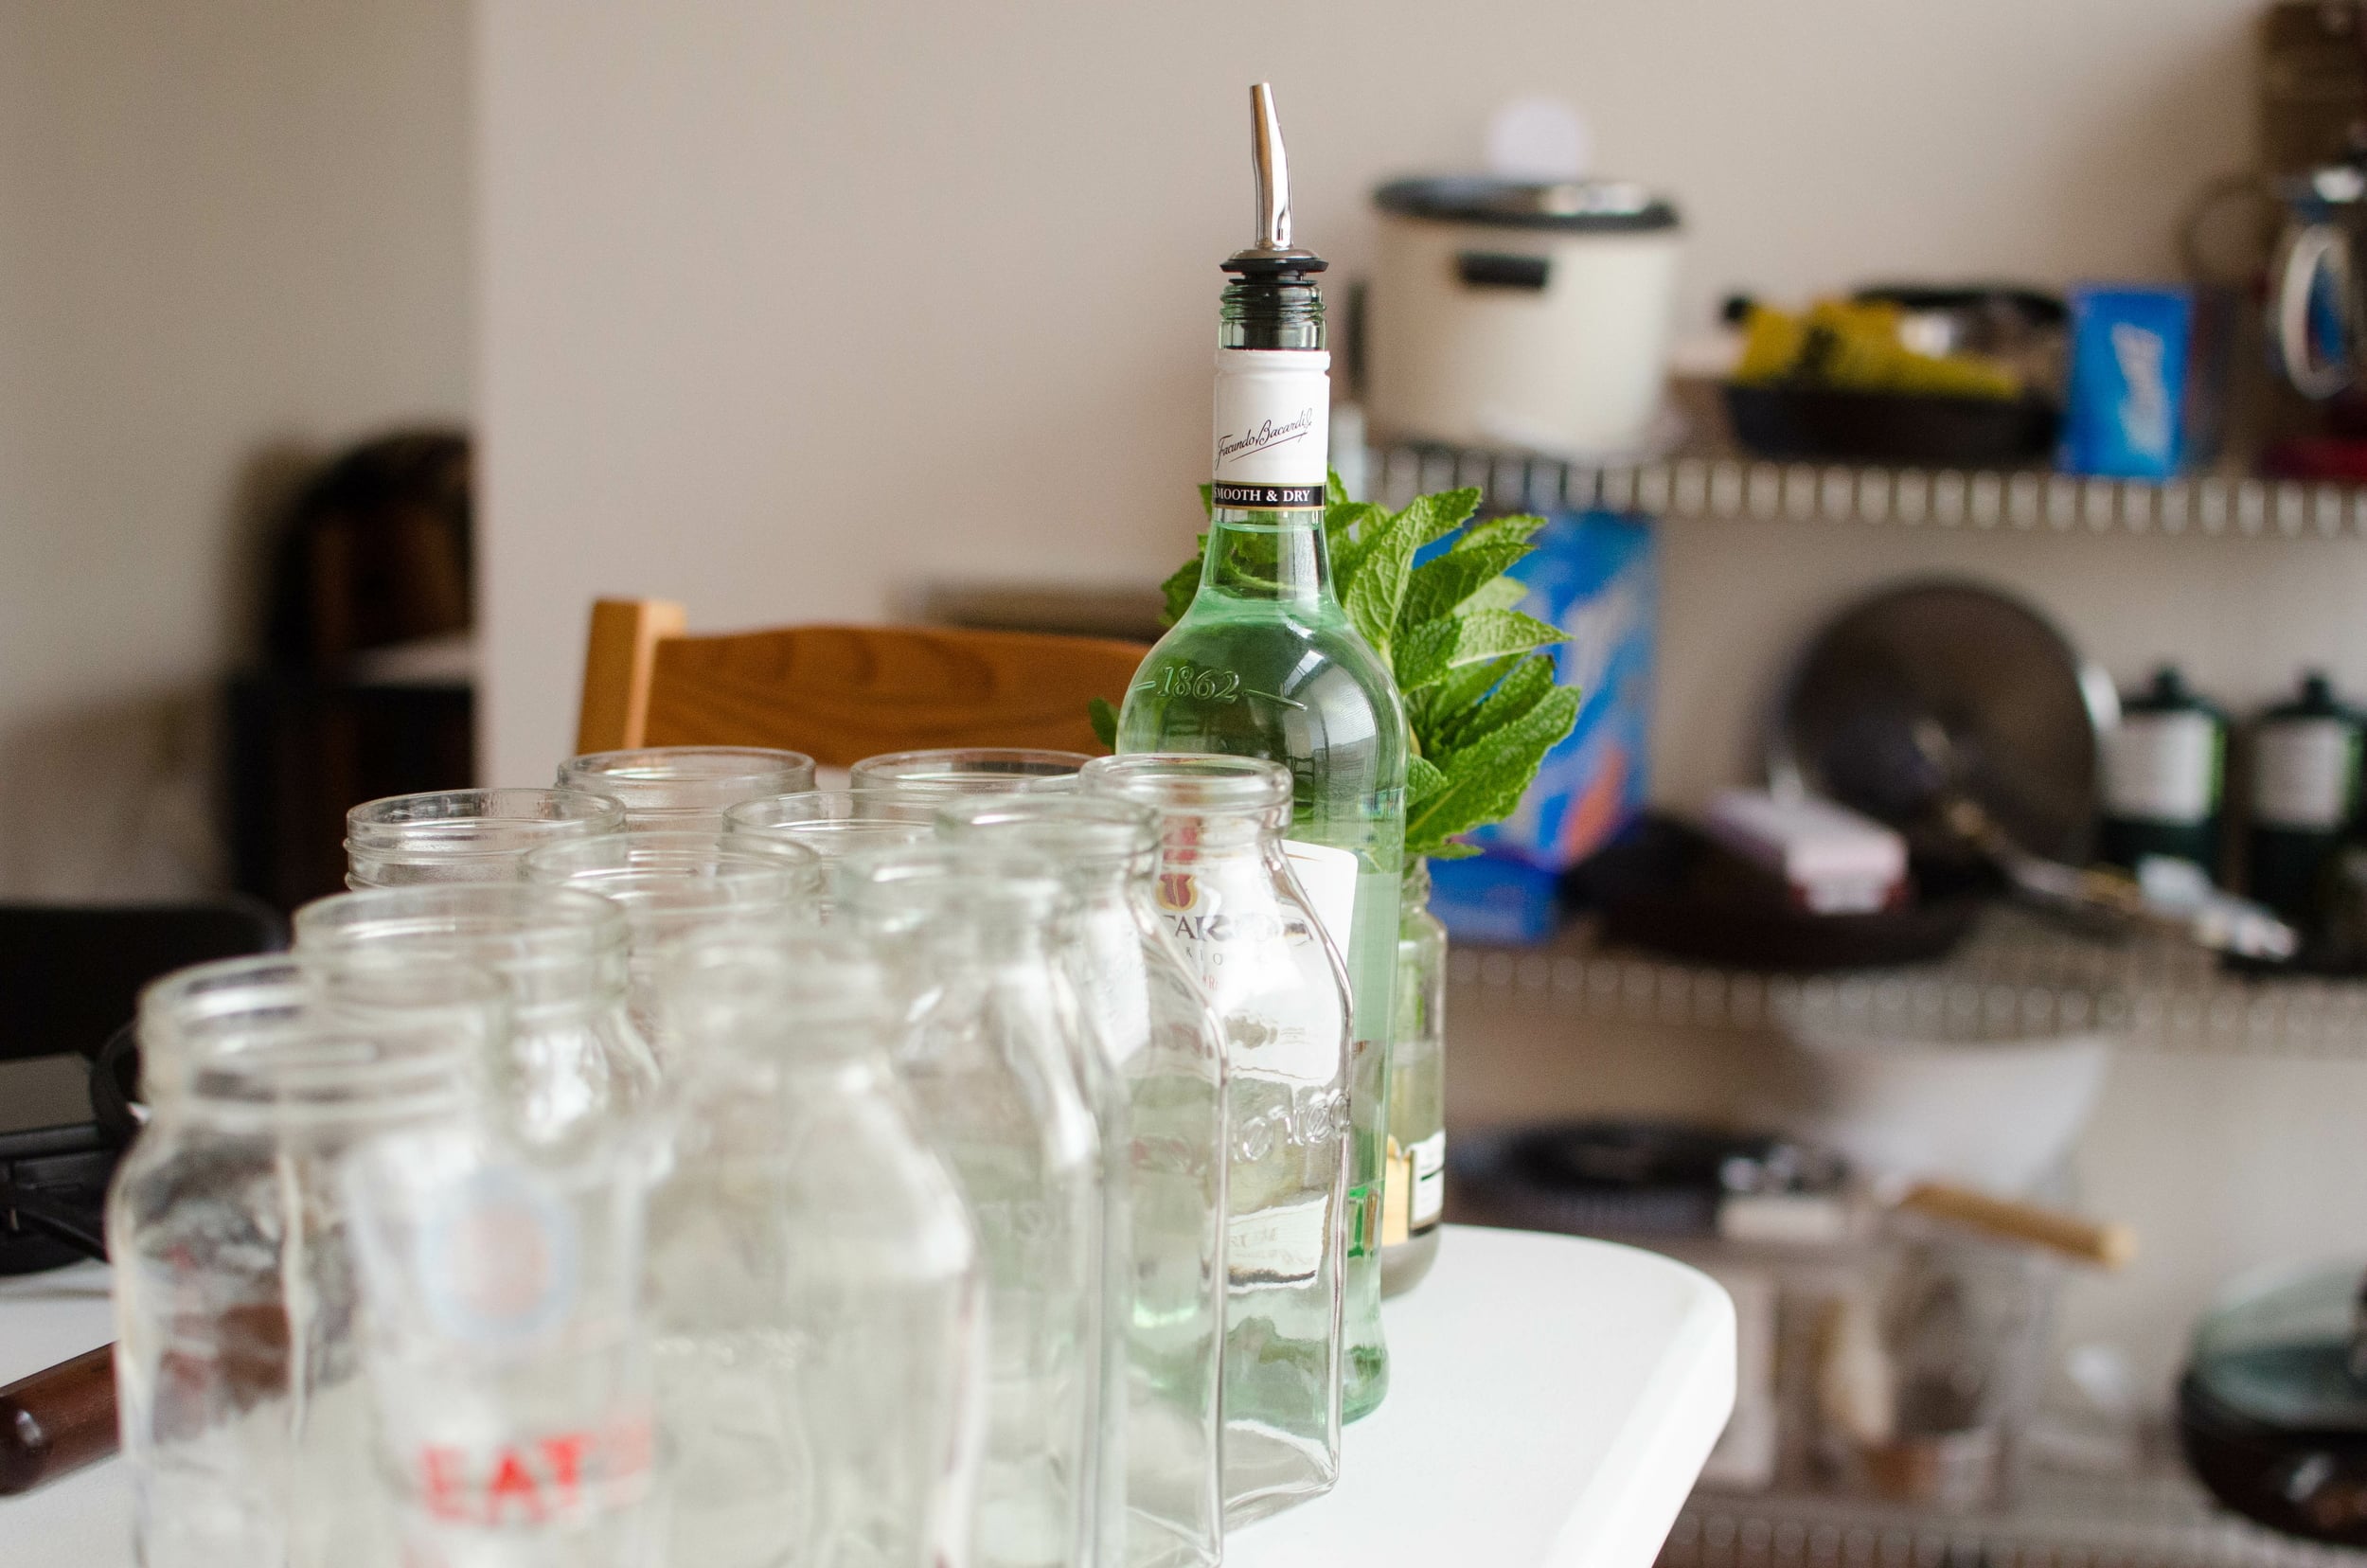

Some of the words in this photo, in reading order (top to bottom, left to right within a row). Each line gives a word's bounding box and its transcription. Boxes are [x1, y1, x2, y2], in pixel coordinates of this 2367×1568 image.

[1214, 429, 1255, 471] Facundo
[1266, 490, 1278, 502] &
[1283, 490, 1310, 502] DRY
[1157, 666, 1239, 704] 1862
